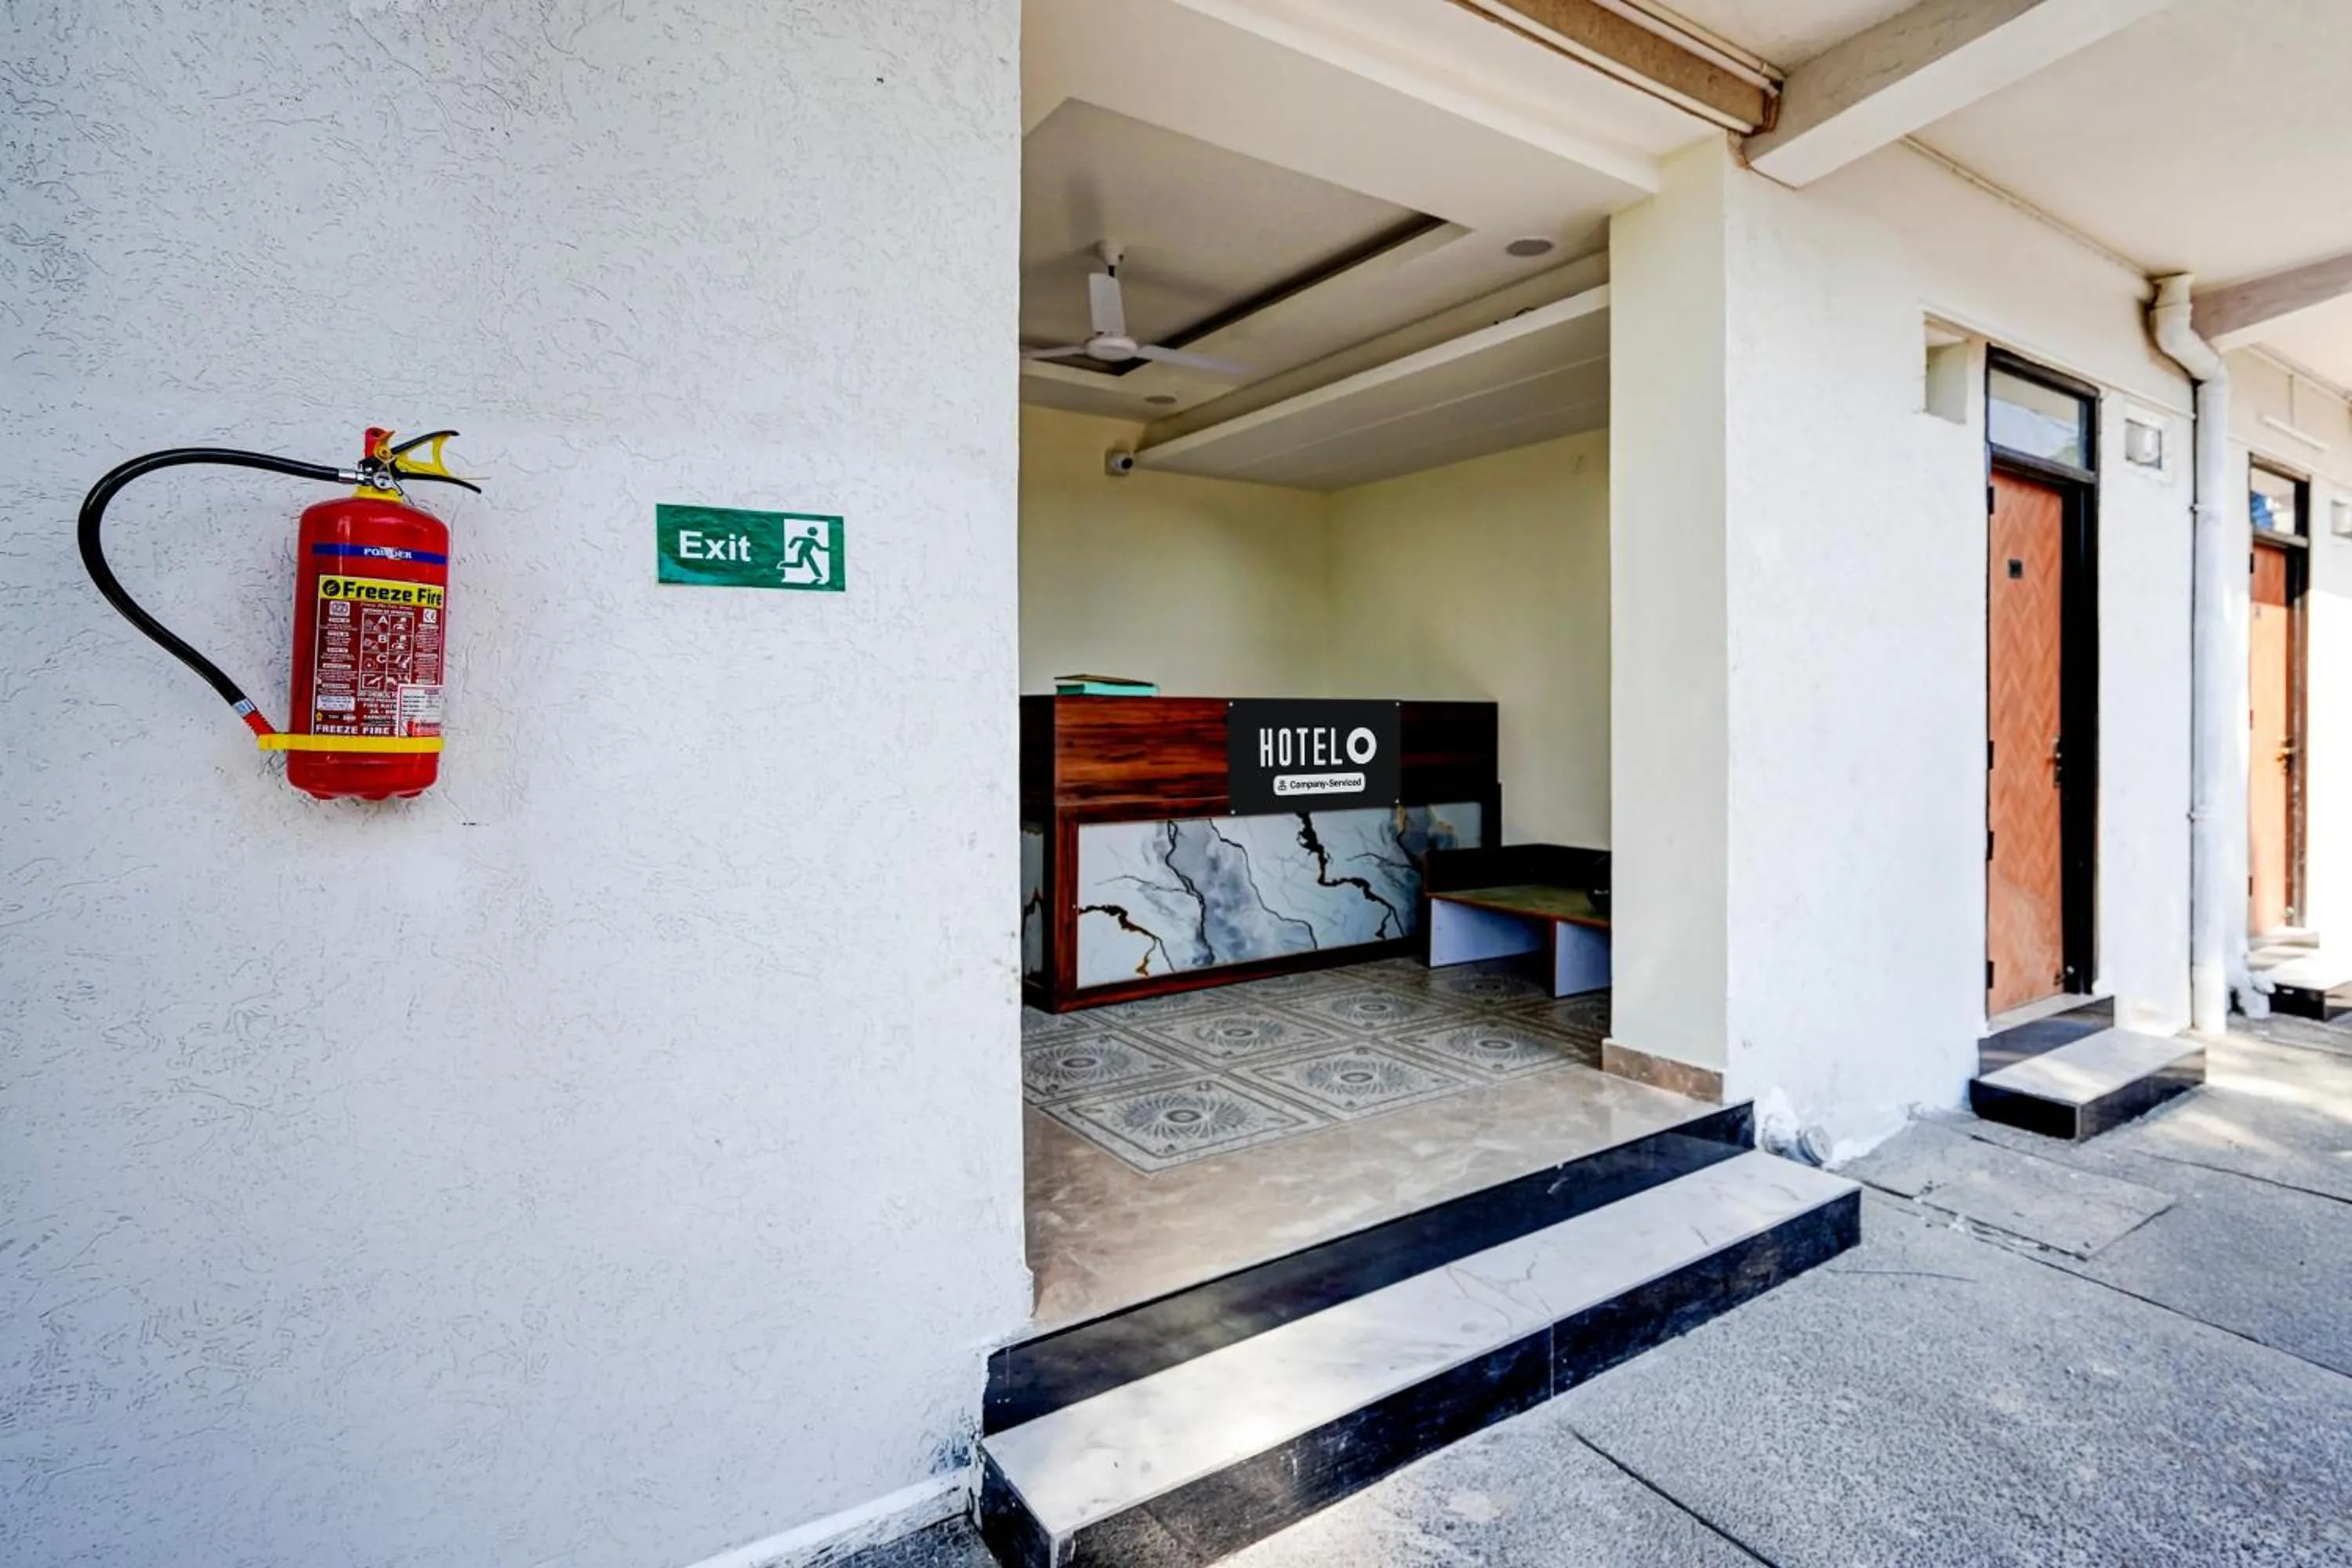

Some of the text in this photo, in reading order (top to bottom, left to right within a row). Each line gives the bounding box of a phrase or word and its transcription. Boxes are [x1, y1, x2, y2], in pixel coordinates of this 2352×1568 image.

[679, 530, 751, 562] Exit
[343, 581, 442, 605] Freeze Fire
[378, 615, 388, 625] A
[316, 724, 358, 735] FREEZE
